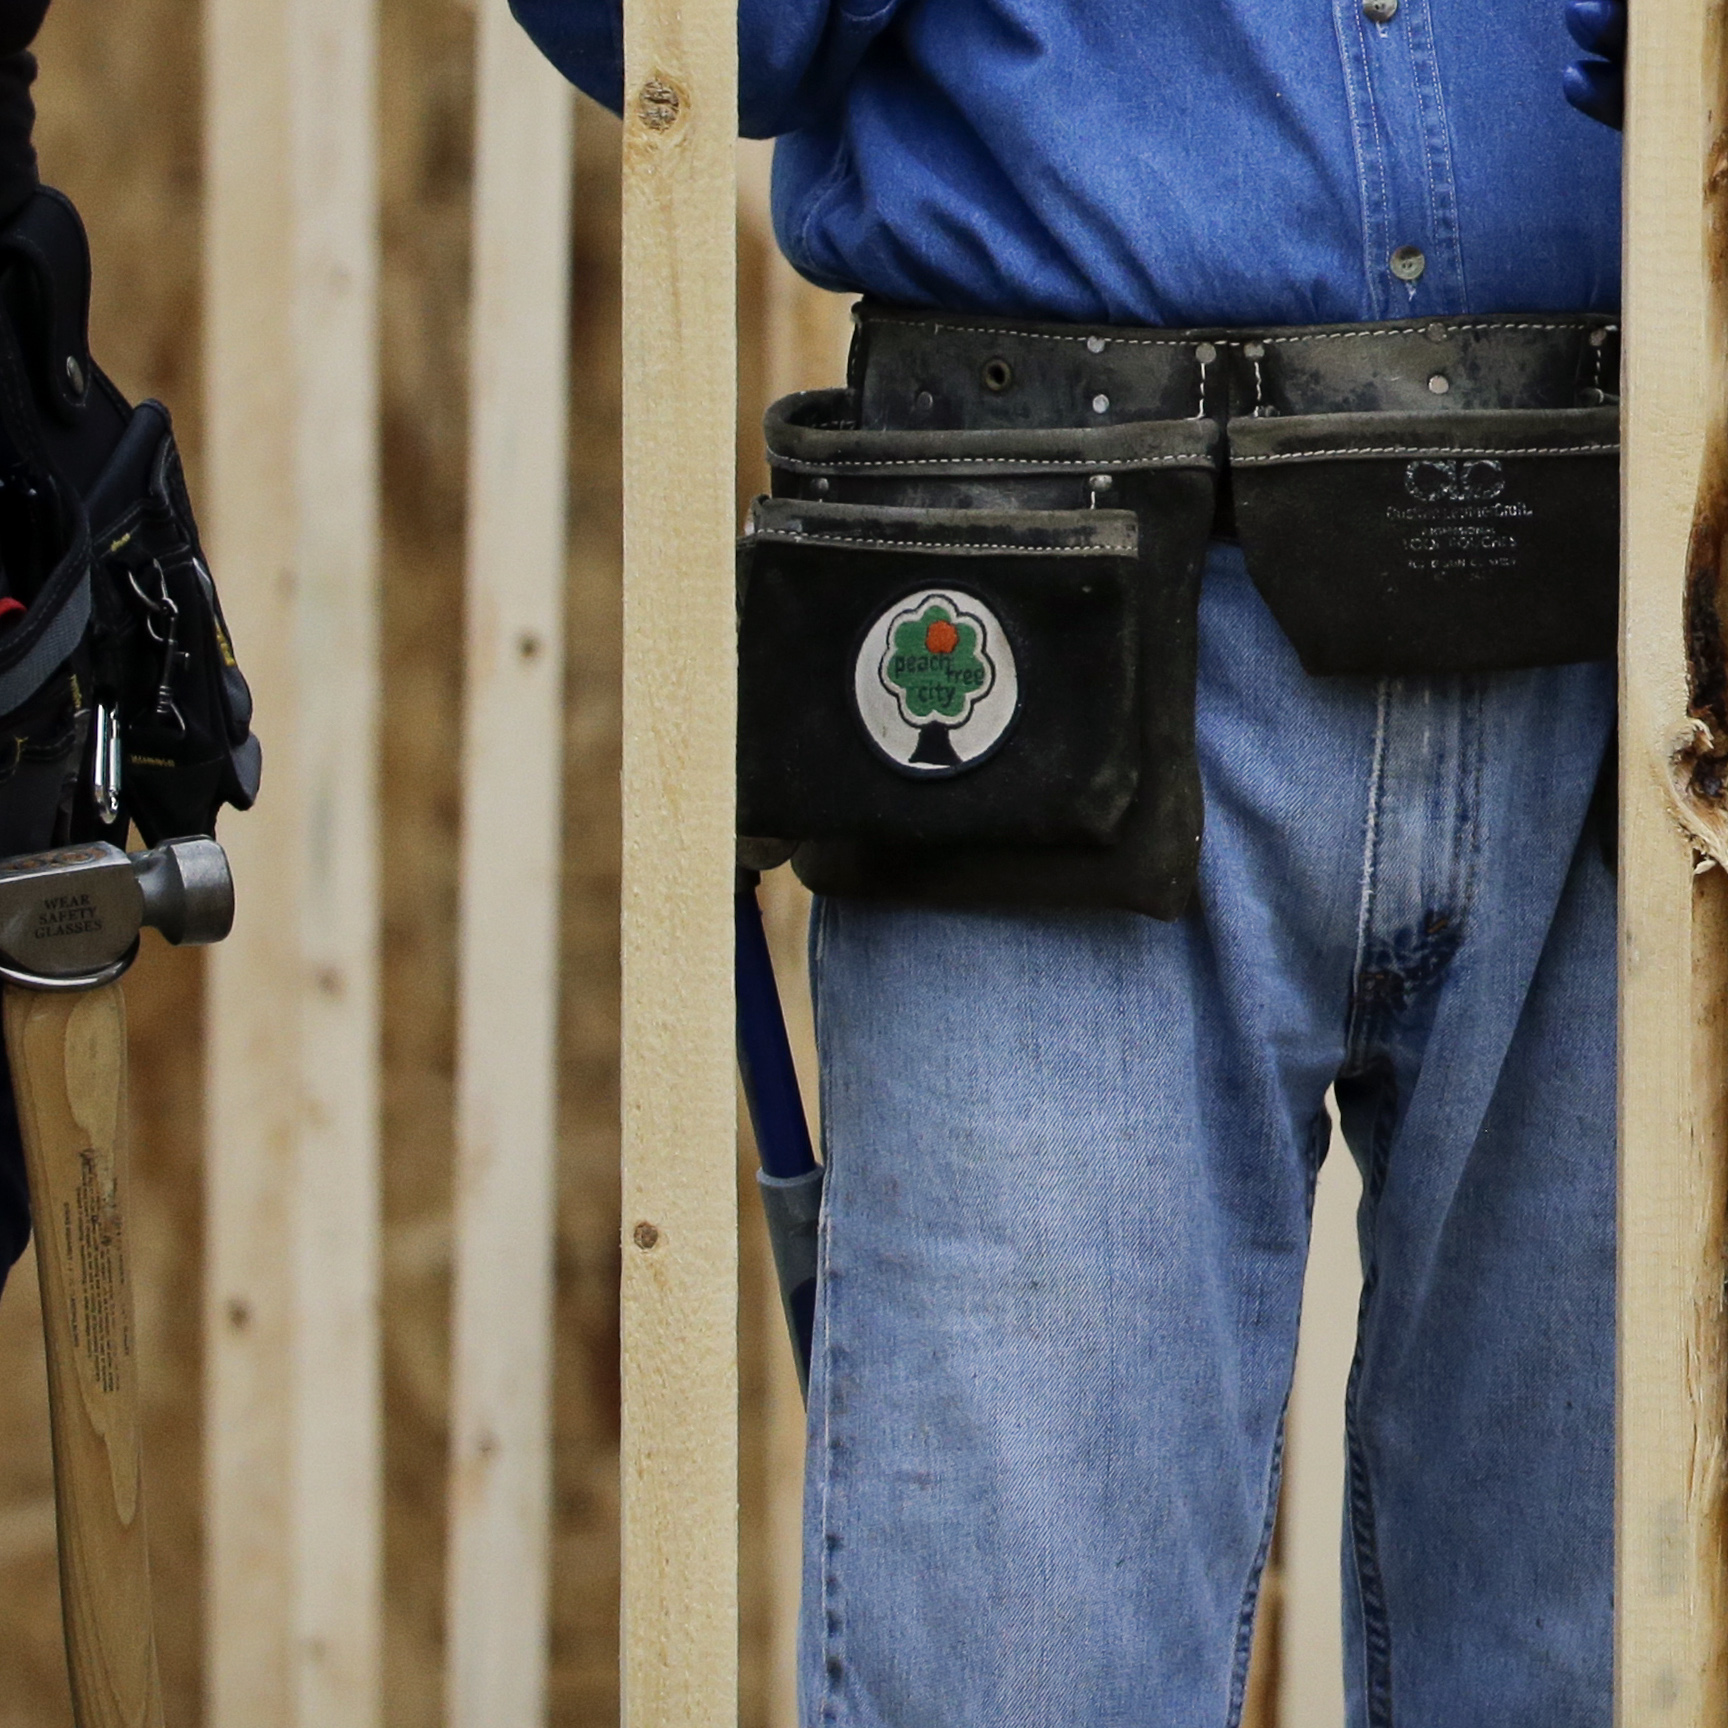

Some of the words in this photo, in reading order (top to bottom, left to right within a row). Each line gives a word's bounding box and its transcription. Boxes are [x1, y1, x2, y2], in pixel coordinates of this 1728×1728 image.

[895, 654, 951, 679] peach
[946, 666, 985, 686] tree
[917, 680, 956, 708] city
[44, 894, 91, 909] WEAR
[39, 906, 97, 925] SAFETY
[35, 919, 103, 939] GLASSES
